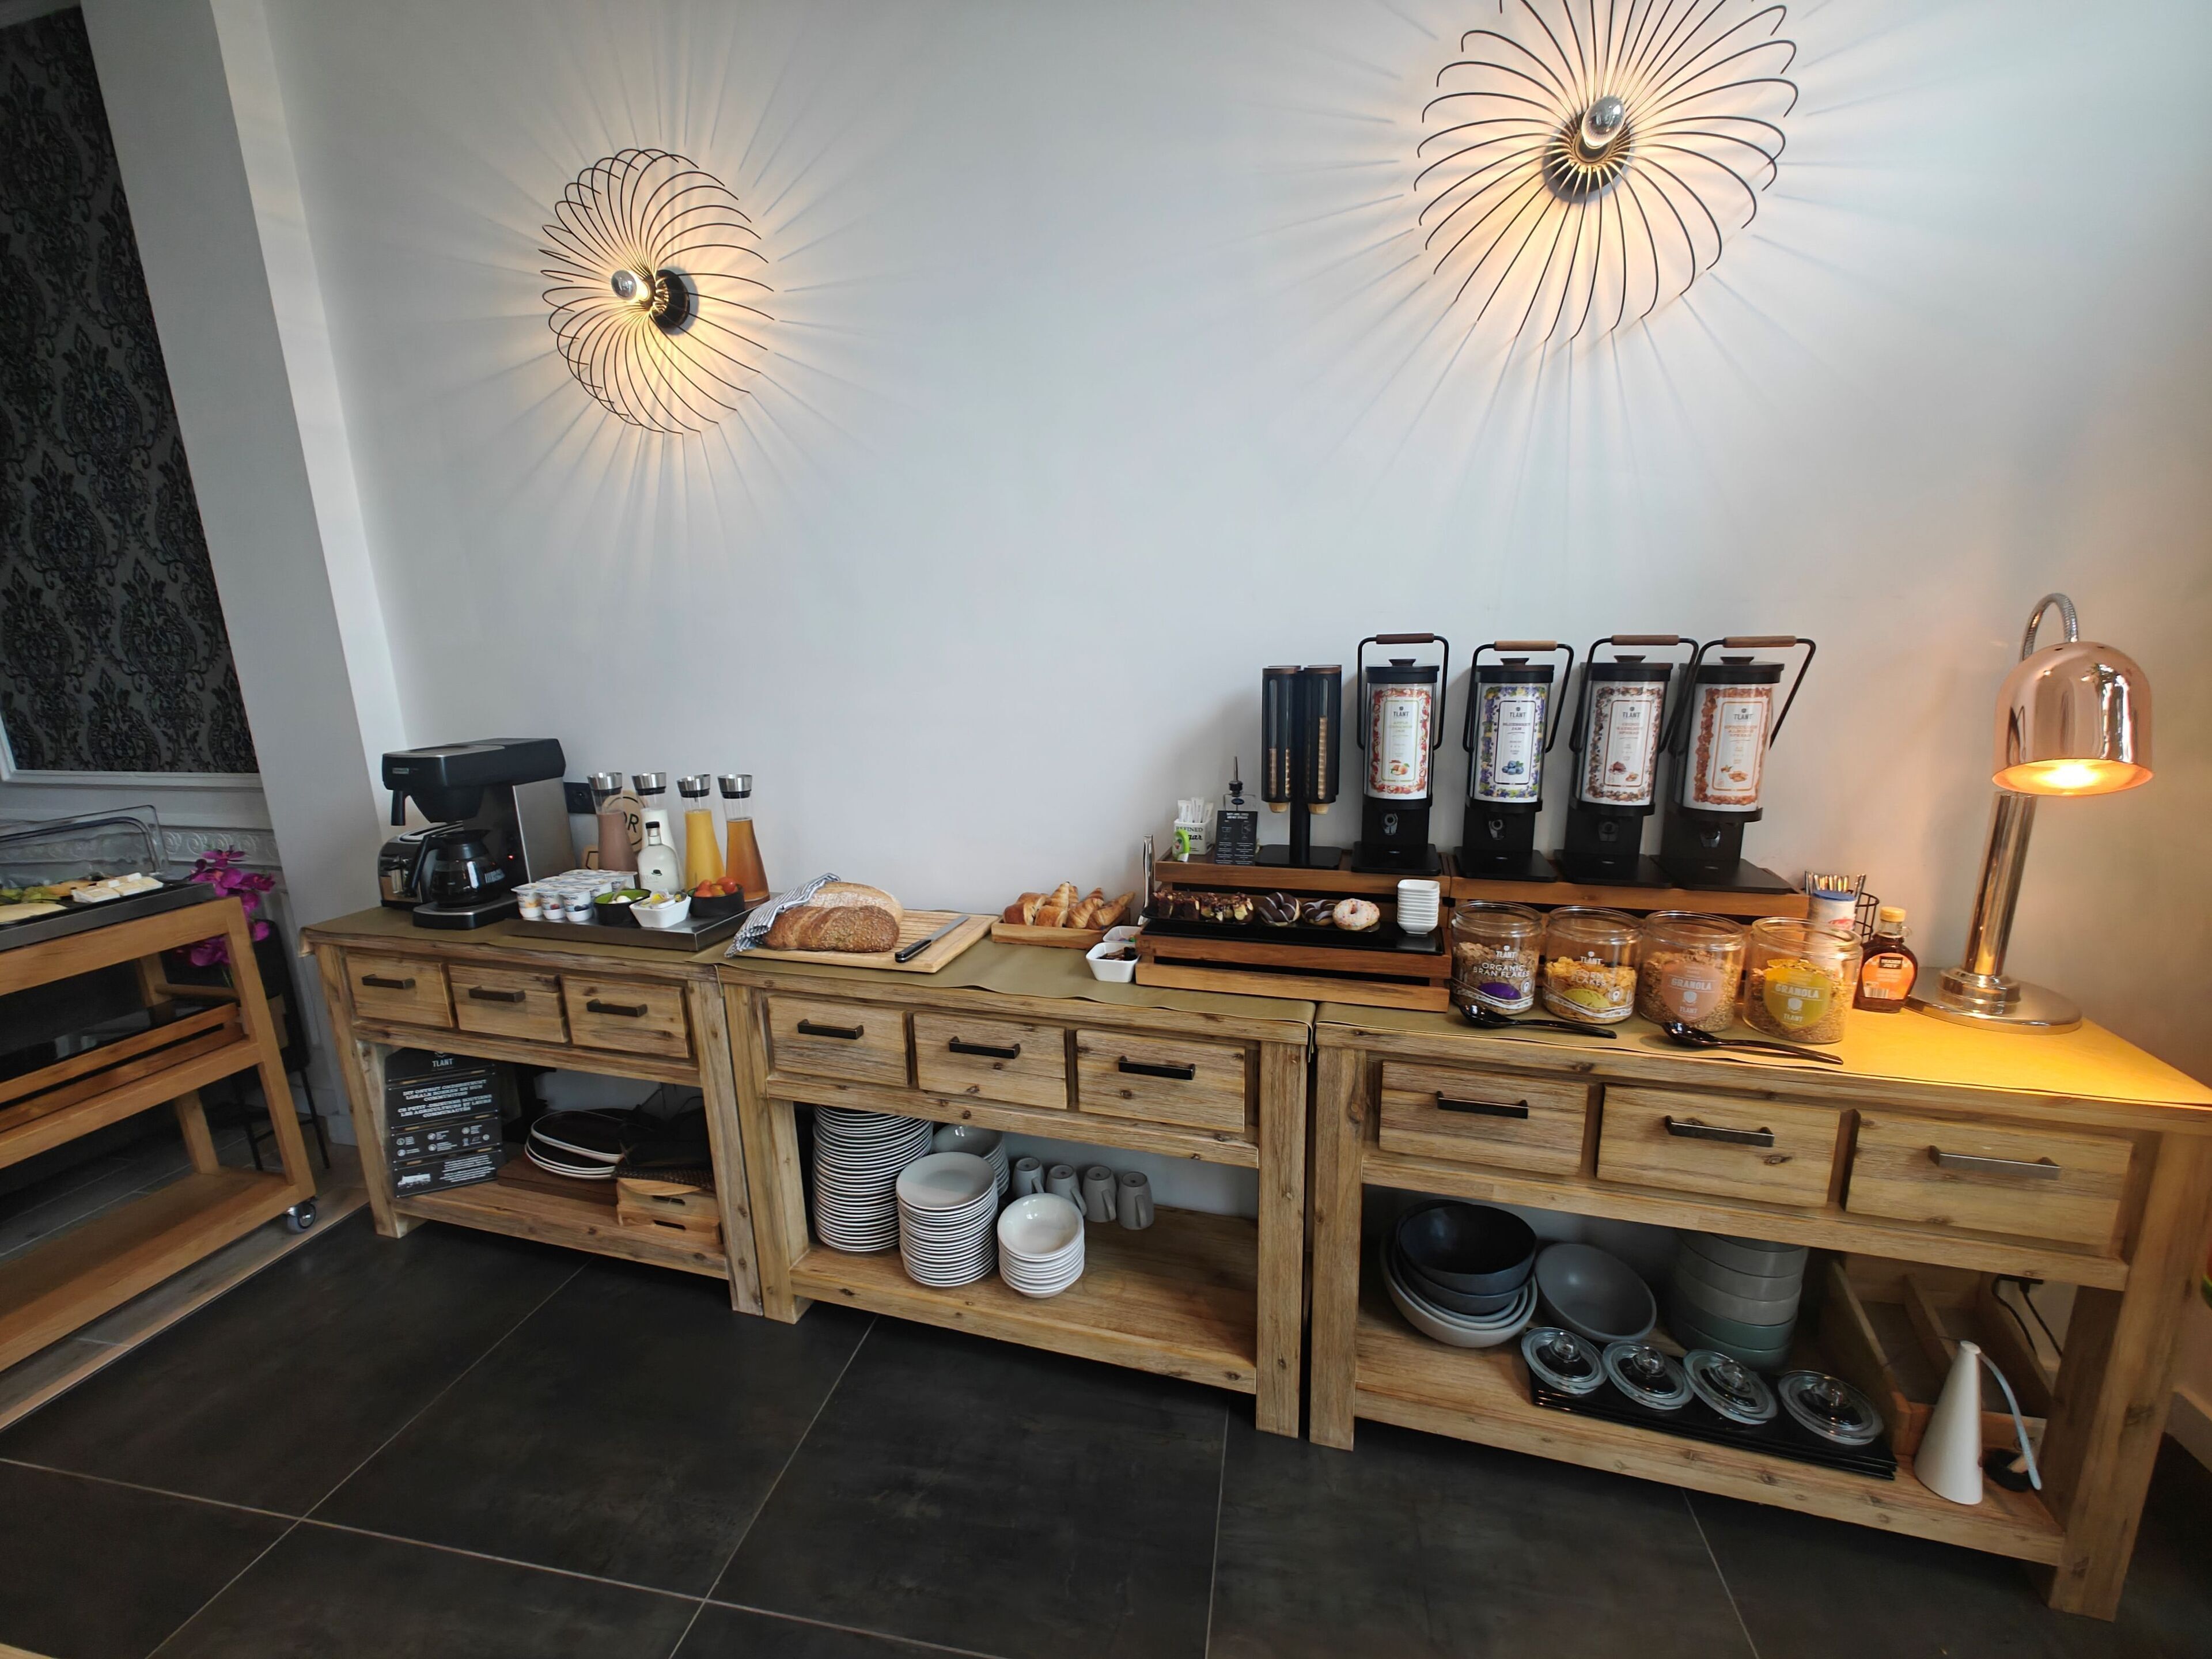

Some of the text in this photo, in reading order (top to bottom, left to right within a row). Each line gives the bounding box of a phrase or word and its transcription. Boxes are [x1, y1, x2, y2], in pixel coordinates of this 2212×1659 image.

[1473, 967, 1530, 978] BRAN FLAKES
[1482, 962, 1527, 972] ORGANIC
[1571, 975, 1607, 986] FLAKES
[1671, 977, 1712, 991] GRANOLA
[1775, 983, 1819, 999] GRANOLA
[431, 1058, 453, 1067] TLANT
